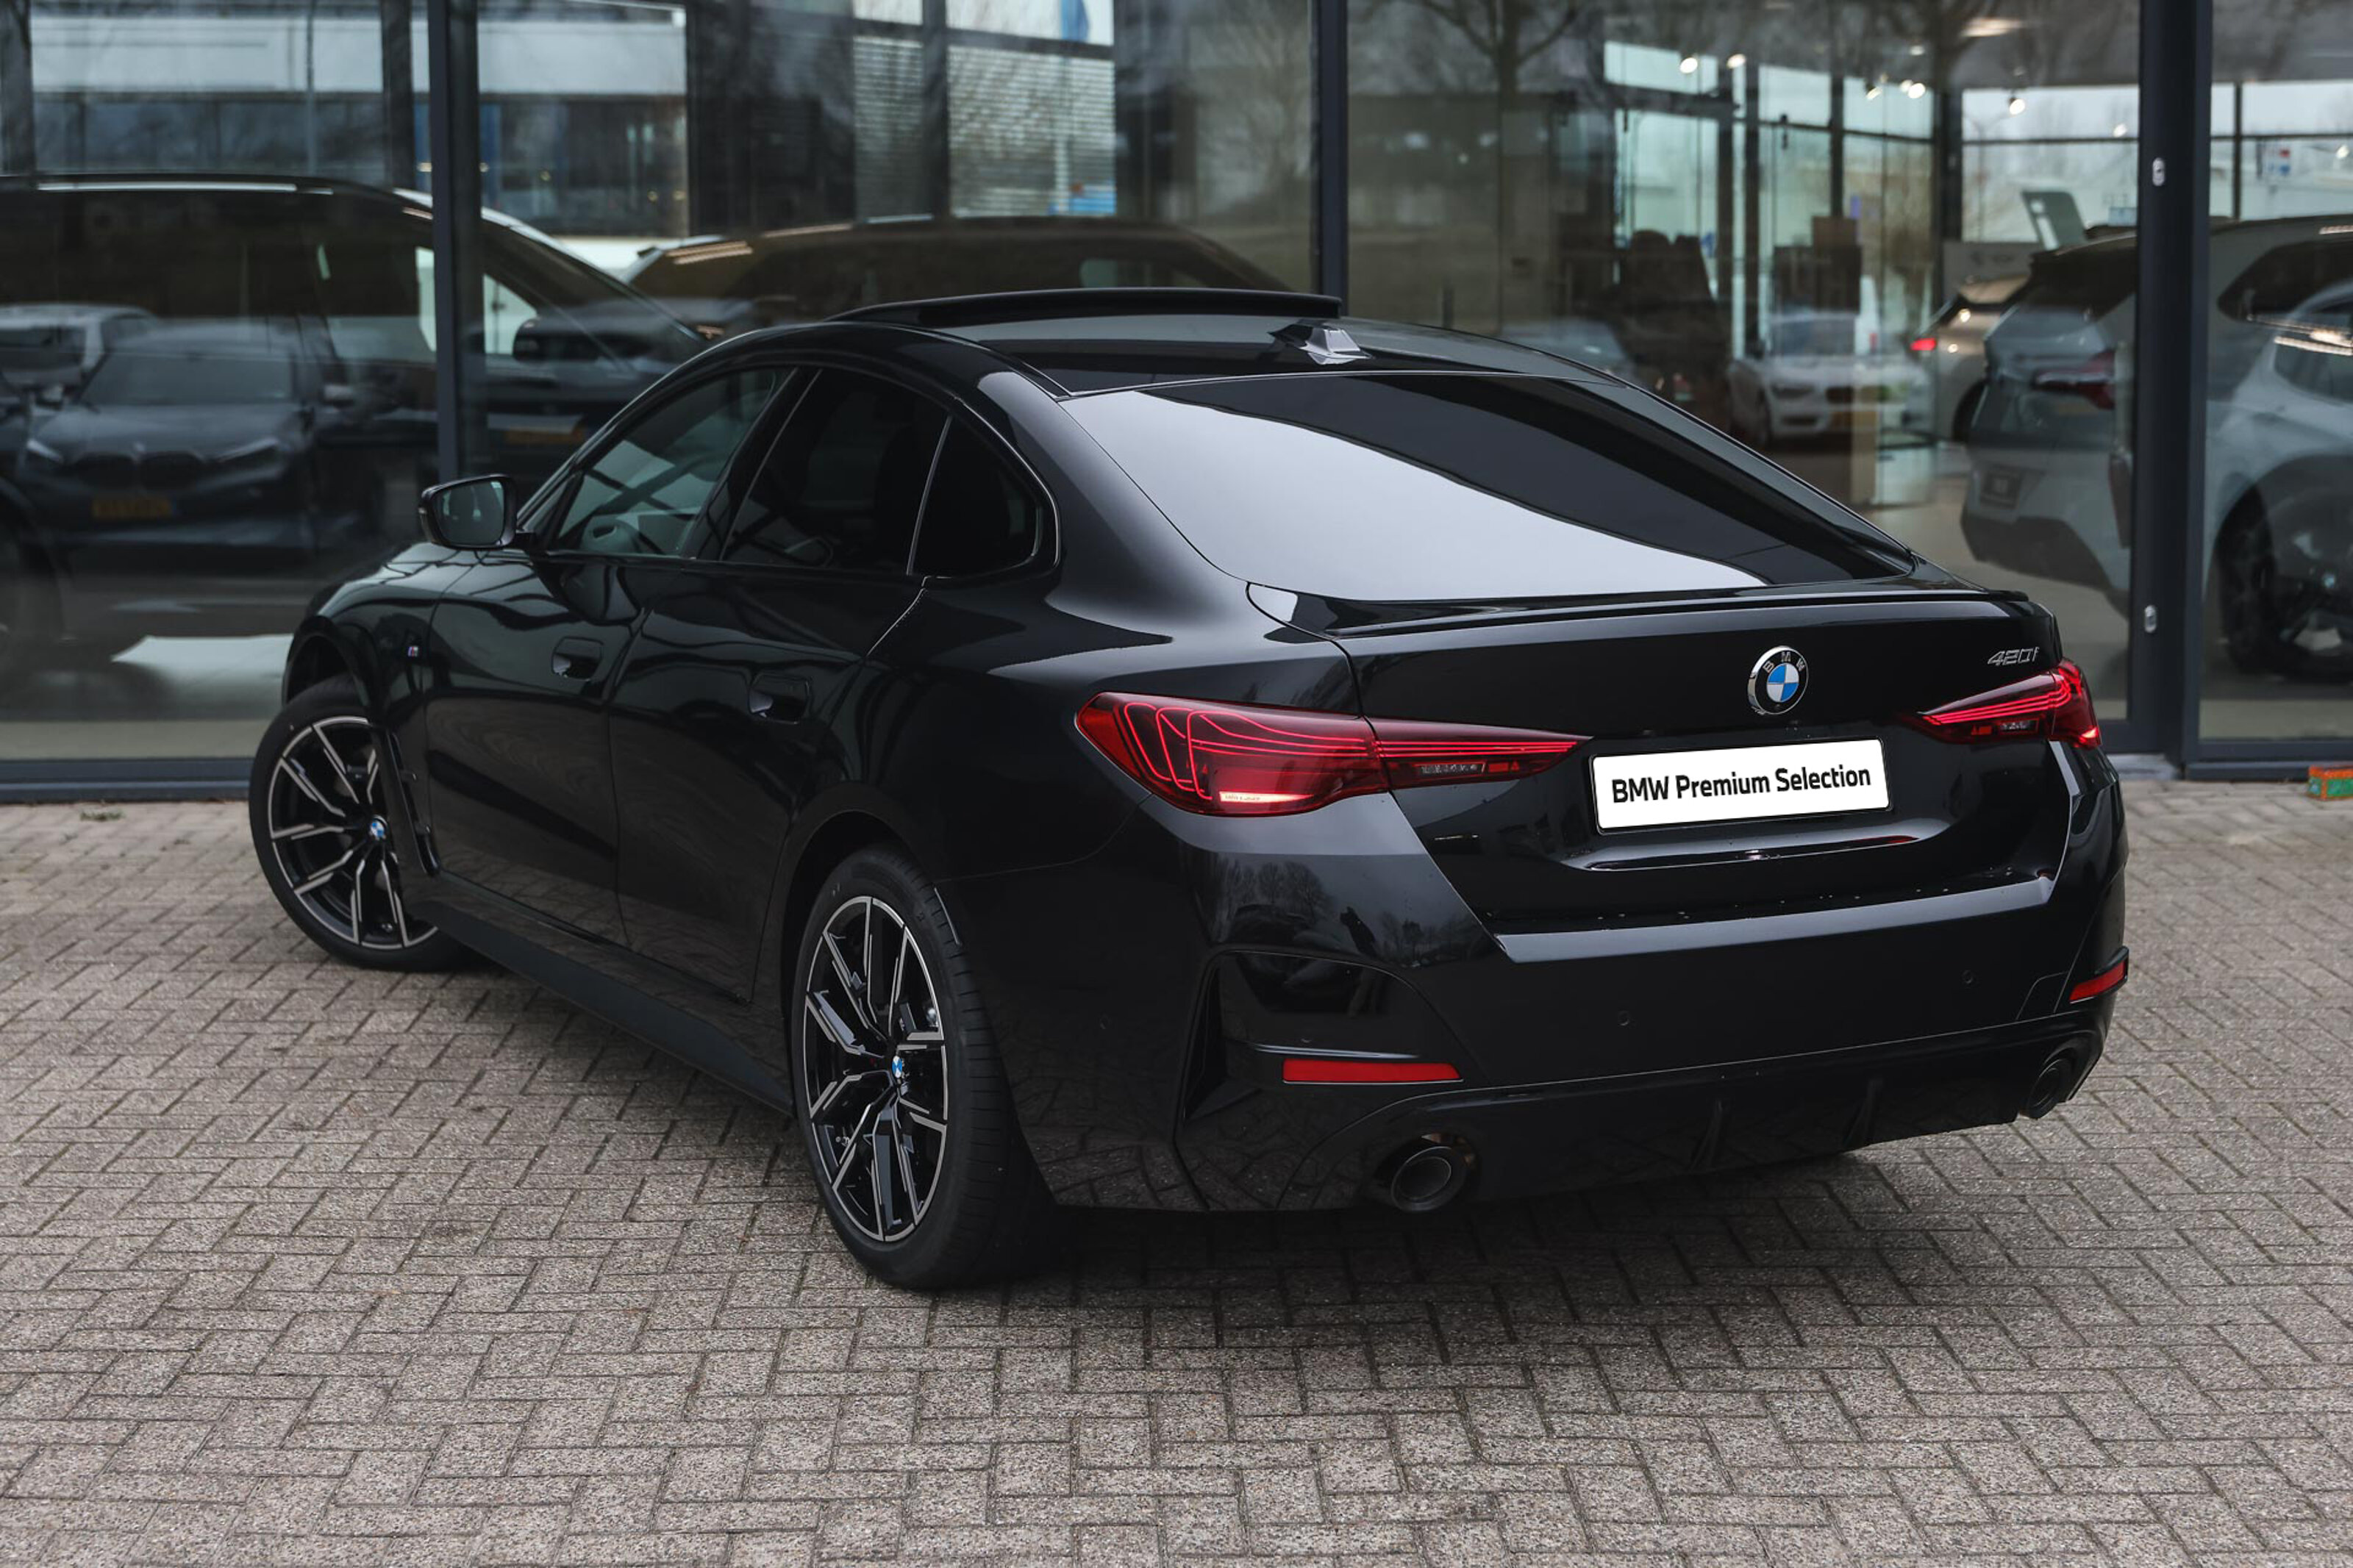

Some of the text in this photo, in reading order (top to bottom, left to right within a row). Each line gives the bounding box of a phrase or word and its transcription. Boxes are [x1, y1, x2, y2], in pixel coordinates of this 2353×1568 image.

[1987, 647, 2040, 666] 420i
[1612, 764, 1871, 803] BMW Premium Selection
